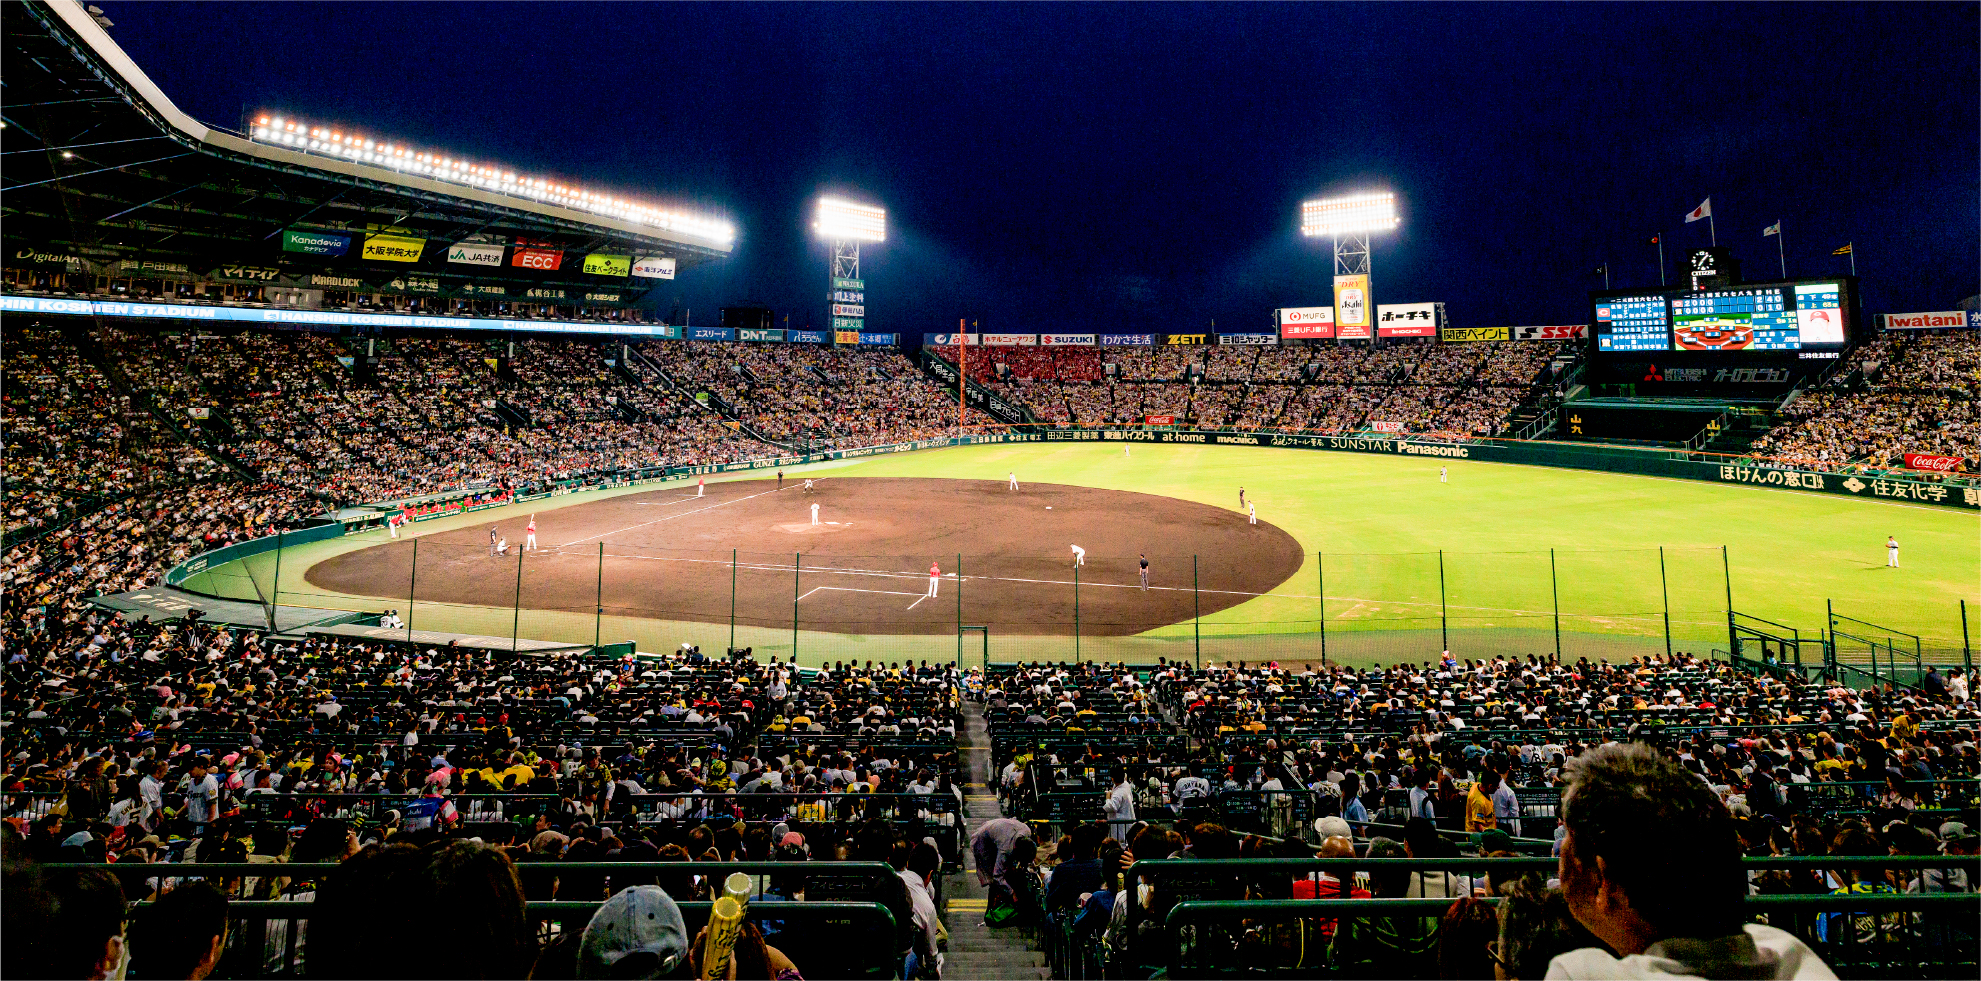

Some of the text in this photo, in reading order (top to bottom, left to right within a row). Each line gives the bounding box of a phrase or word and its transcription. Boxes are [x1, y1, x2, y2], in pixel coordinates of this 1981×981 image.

[291, 235, 342, 247] Kanadevia
[365, 245, 420, 257] 大阪学院大学
[468, 253, 500, 263] JA共済
[522, 255, 553, 269] ECC
[142, 261, 188, 272] 戸田建設
[584, 264, 627, 275] 住友ベークライト
[311, 274, 360, 287] HARDLOCK
[407, 277, 439, 289] 森本組
[38, 301, 128, 314] KOSHIEN
[132, 304, 215, 317] STADIUM
[1341, 300, 1362, 309] Asahi
[281, 312, 471, 327] HANSHIN KOSHIEN STADIUM
[1381, 311, 1431, 321] ホーチキ
[1889, 313, 1963, 327] Iwatani
[515, 322, 653, 333] HANSHIN KOSHIEN STADIUM
[834, 318, 863, 328] 日新火災
[695, 330, 727, 338] エスリード
[740, 331, 767, 340] DNT
[1287, 326, 1328, 334] 三菱UFJ銀行
[1443, 329, 1508, 340] 関西ペイント
[1540, 326, 1585, 338] SSK
[841, 333, 859, 343] 黄桜
[984, 336, 1036, 344] ホテルニューアワジ
[1054, 336, 1093, 344] SUZUKI
[1102, 335, 1151, 345] わかさ生活
[1167, 333, 1207, 345] ZETT
[930, 360, 956, 384] 大同生命
[1148, 416, 1171, 424] Coca-Cola
[1047, 431, 1099, 440] 田辺三菱製薬
[1103, 431, 1155, 440] 東進ハイスクール
[1162, 431, 1206, 442] at home
[1330, 439, 1392, 451] SUNSTAR
[1397, 441, 1469, 458] Panasonic
[753, 459, 776, 469] GUNZE
[1871, 479, 1948, 501] 住友化学
[811, 881, 868, 890] アイビーシート
